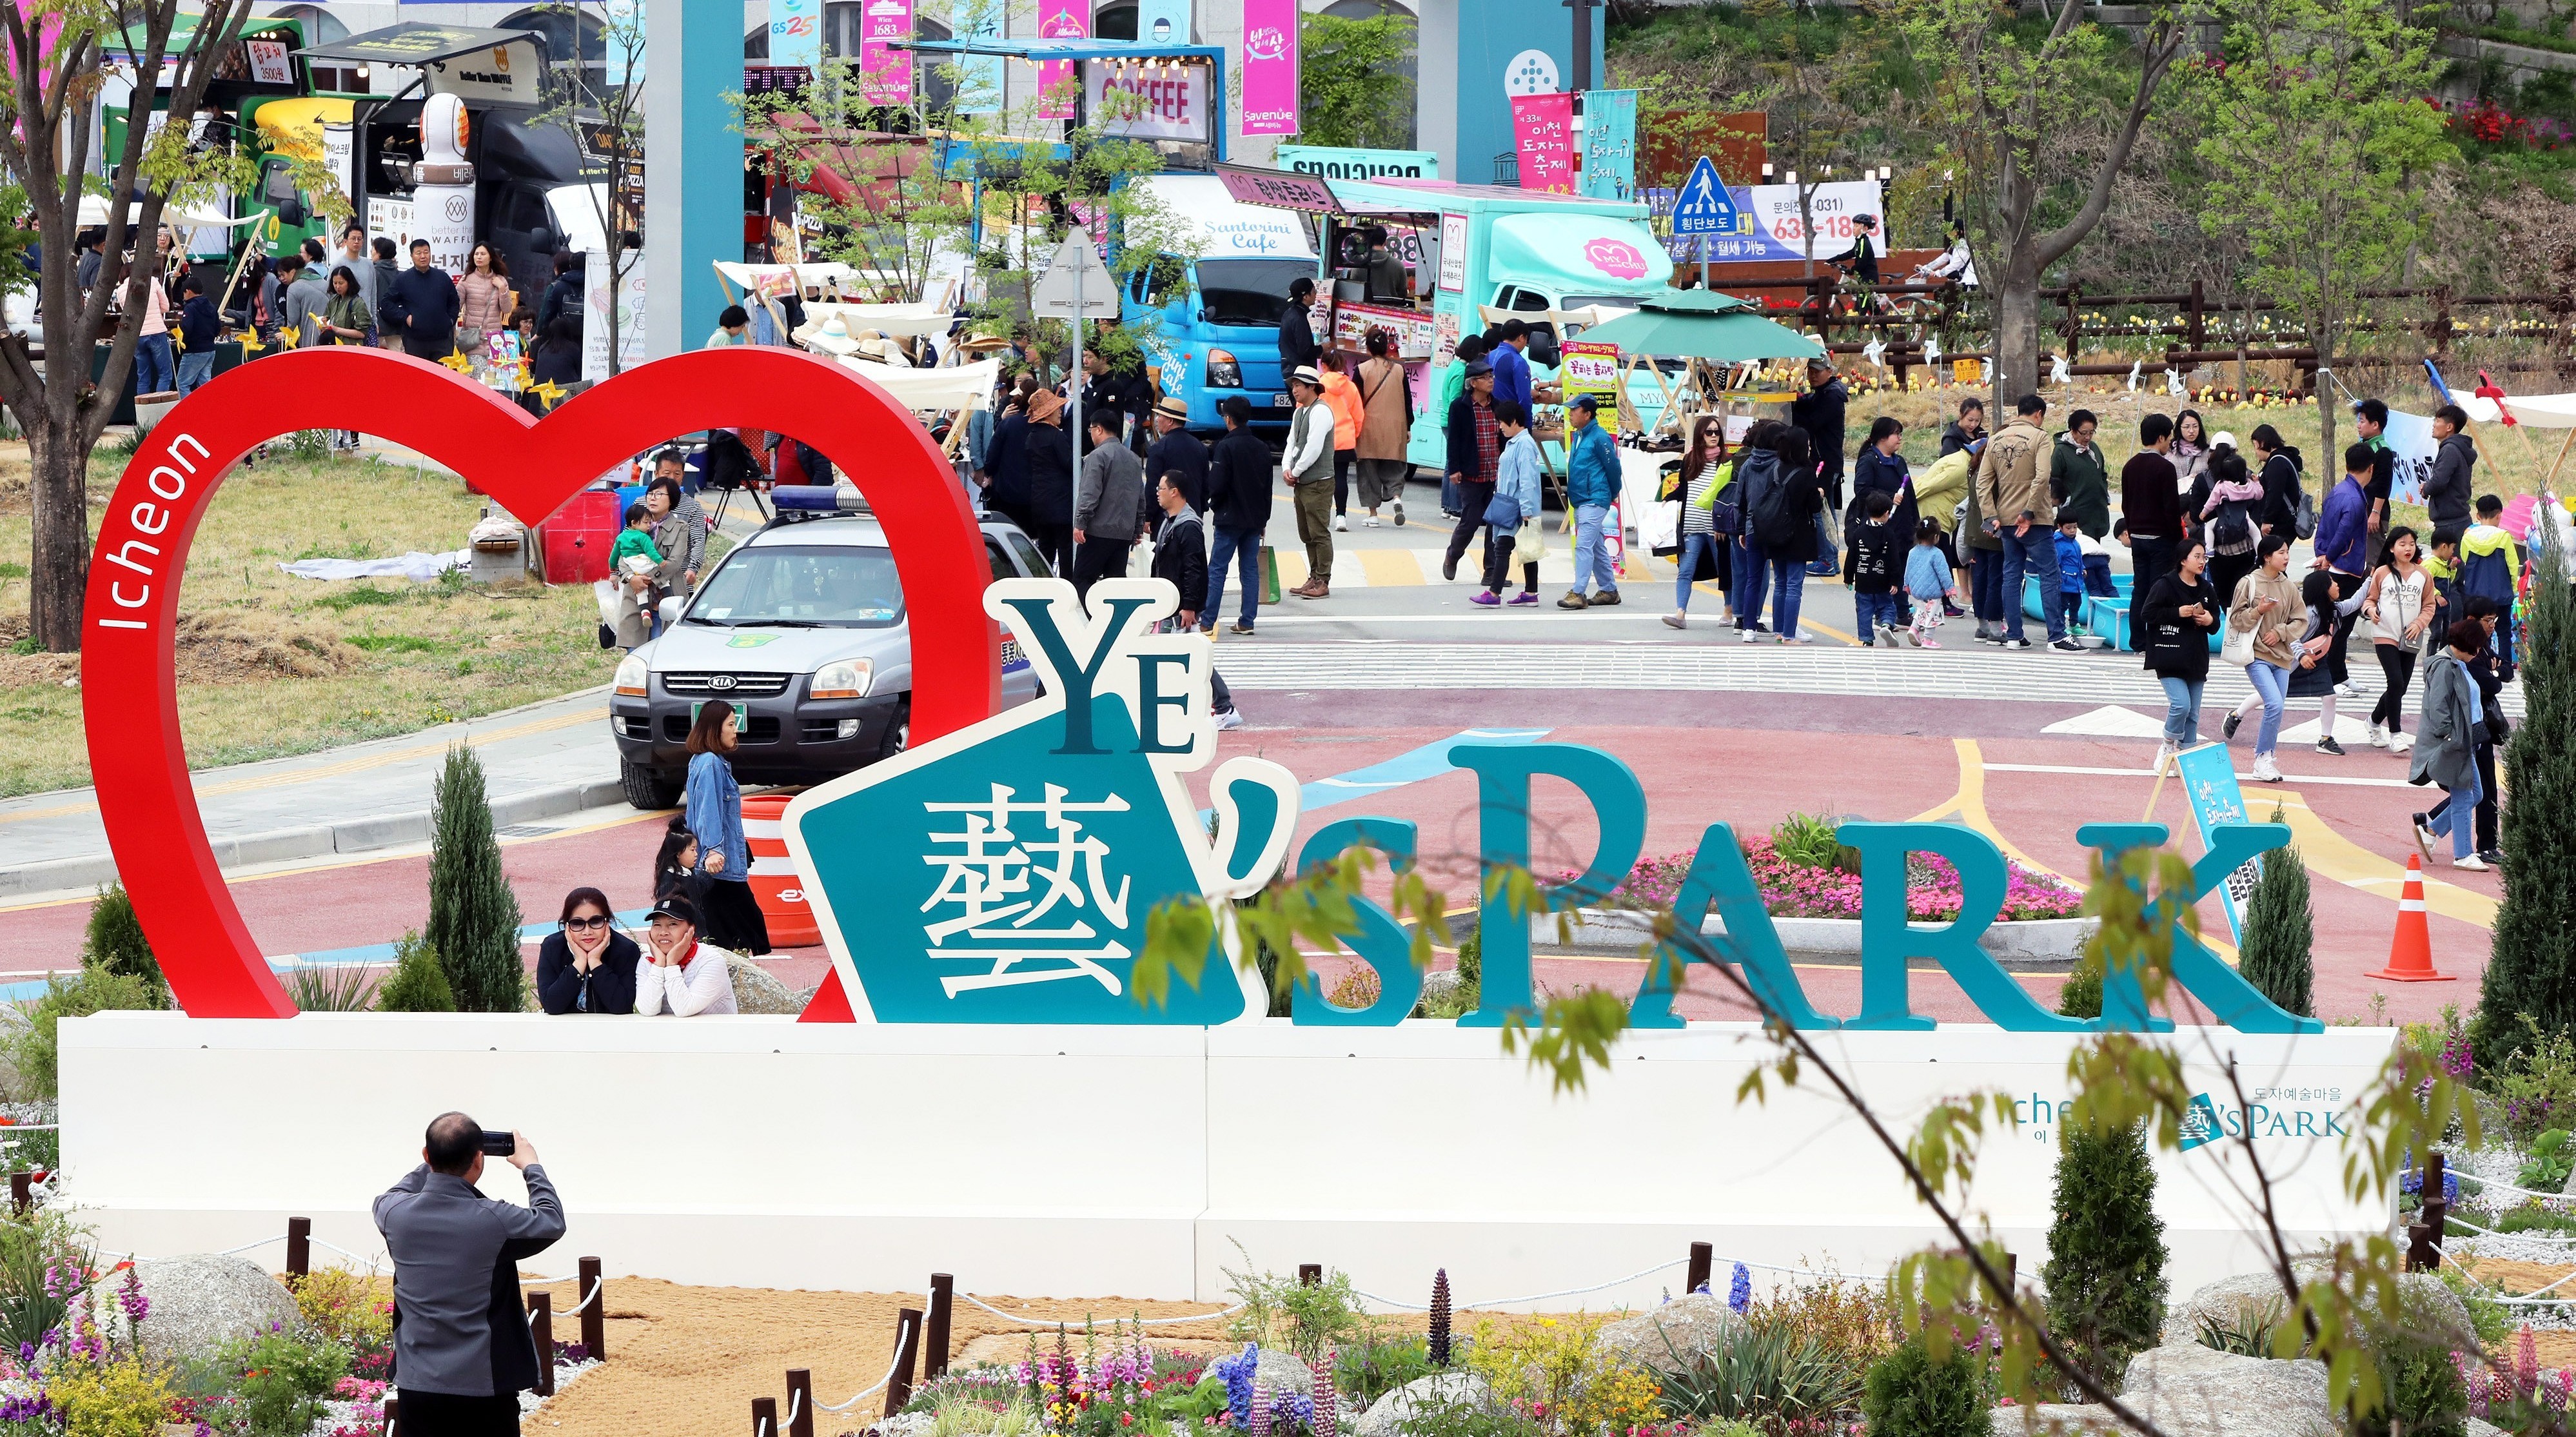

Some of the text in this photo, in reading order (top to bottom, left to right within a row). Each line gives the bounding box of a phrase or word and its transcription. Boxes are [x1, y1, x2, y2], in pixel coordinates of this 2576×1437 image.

[772, 15, 817, 37] GS25
[874, 25, 897, 35] 1683
[1055, 26, 1081, 36] Alibaba
[261, 67, 284, 81] 3500원
[1244, 107, 1293, 122] Savenue
[1532, 121, 1561, 137] 이천
[1522, 139, 1568, 152] 도자기
[1495, 163, 1519, 181] UNES
[1533, 154, 1567, 178] 축제
[1773, 201, 1814, 214] 문의전
[431, 225, 473, 234] better tha
[1205, 221, 1292, 235] Santorini
[1681, 217, 1729, 230] 횡단보도
[1232, 233, 1279, 253] Cafe
[1743, 241, 1766, 255] 가능
[1621, 261, 1646, 270] CHU
[1570, 361, 1614, 376] 꽃피는 솜사탕
[1161, 362, 1183, 395] Cafe
[99, 433, 211, 629] Icheon
[2388, 584, 2421, 596] MDERN
[713, 678, 731, 686] KIA
[921, 781, 1131, 1000] 藝
[2254, 1087, 2343, 1102] 도자예술마을
